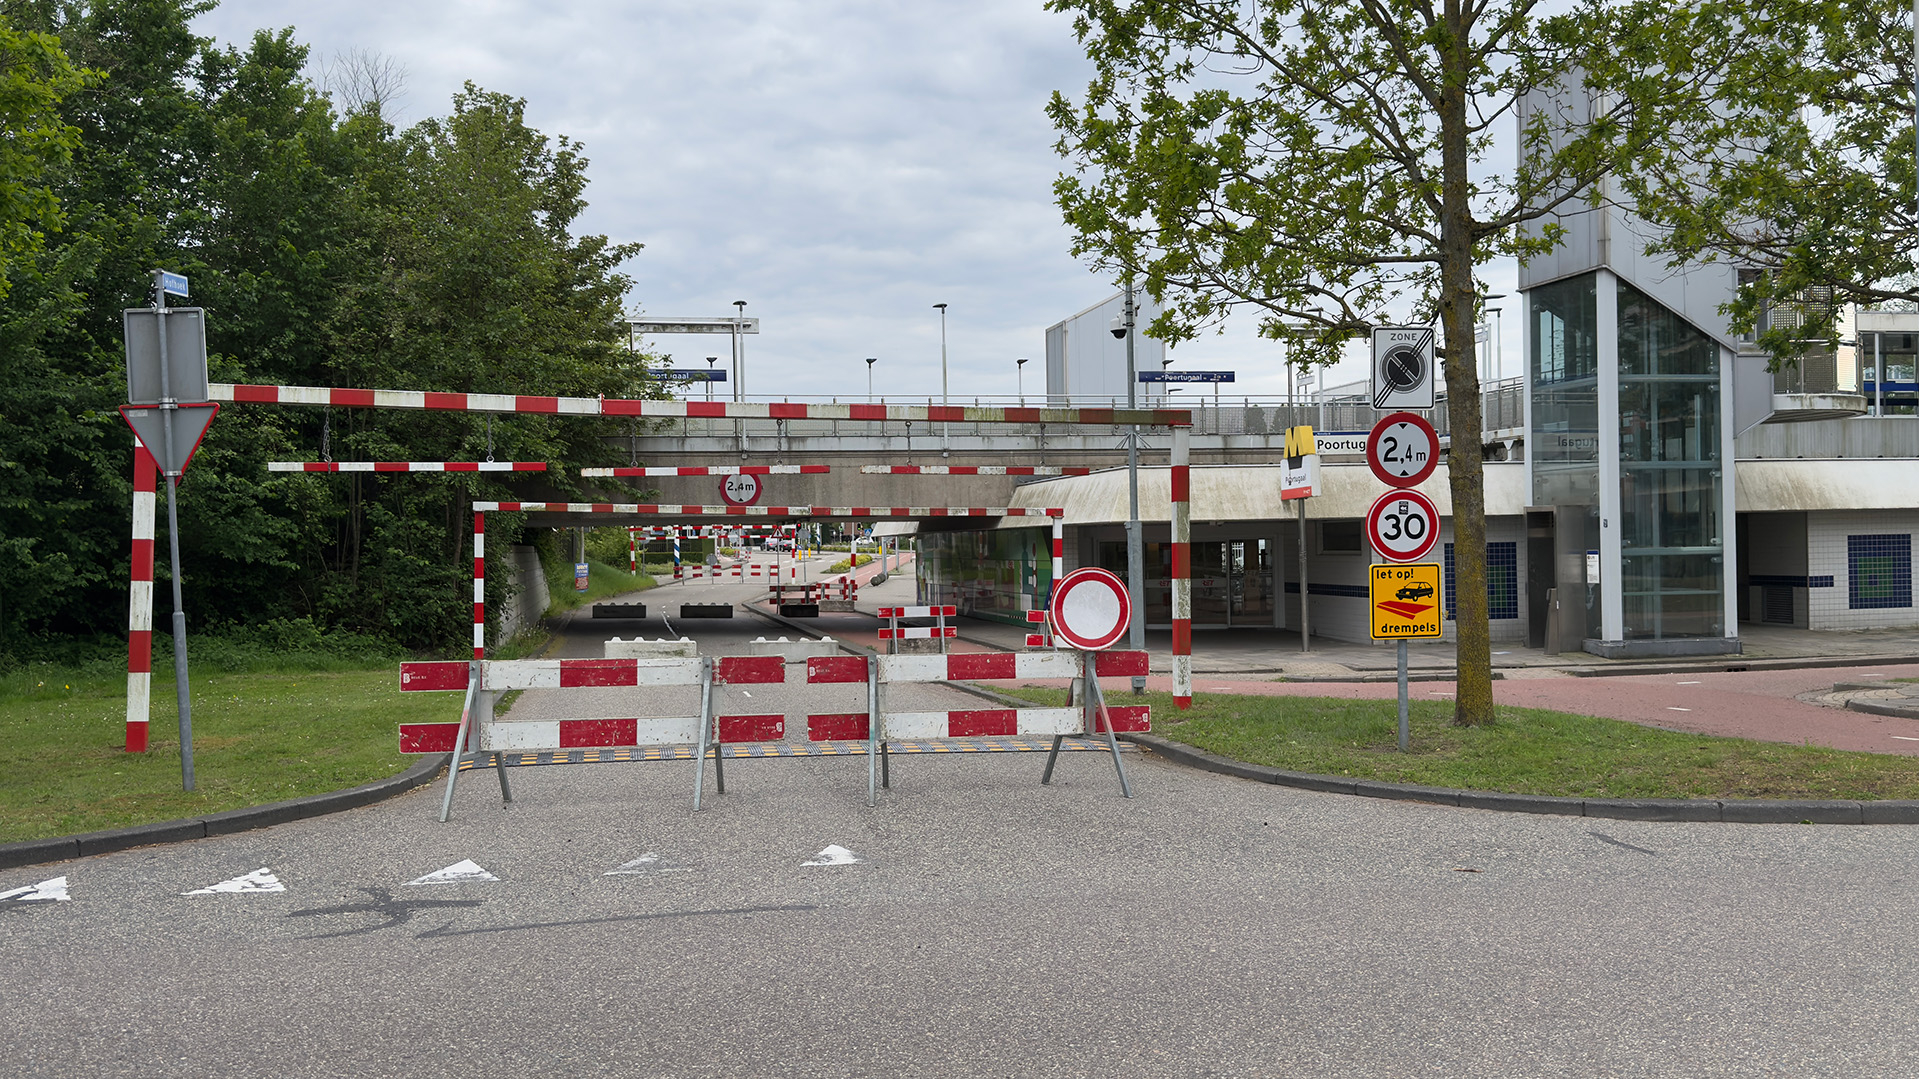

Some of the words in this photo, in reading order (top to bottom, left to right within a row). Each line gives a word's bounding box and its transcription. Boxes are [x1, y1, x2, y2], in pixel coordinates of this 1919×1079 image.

[1390, 333, 1417, 341] ZONE
[1317, 439, 1366, 452] Poortug
[1383, 513, 1426, 541] 30
[1376, 569, 1392, 579] let
[1396, 568, 1414, 580] op!
[1381, 622, 1436, 634] drempels
